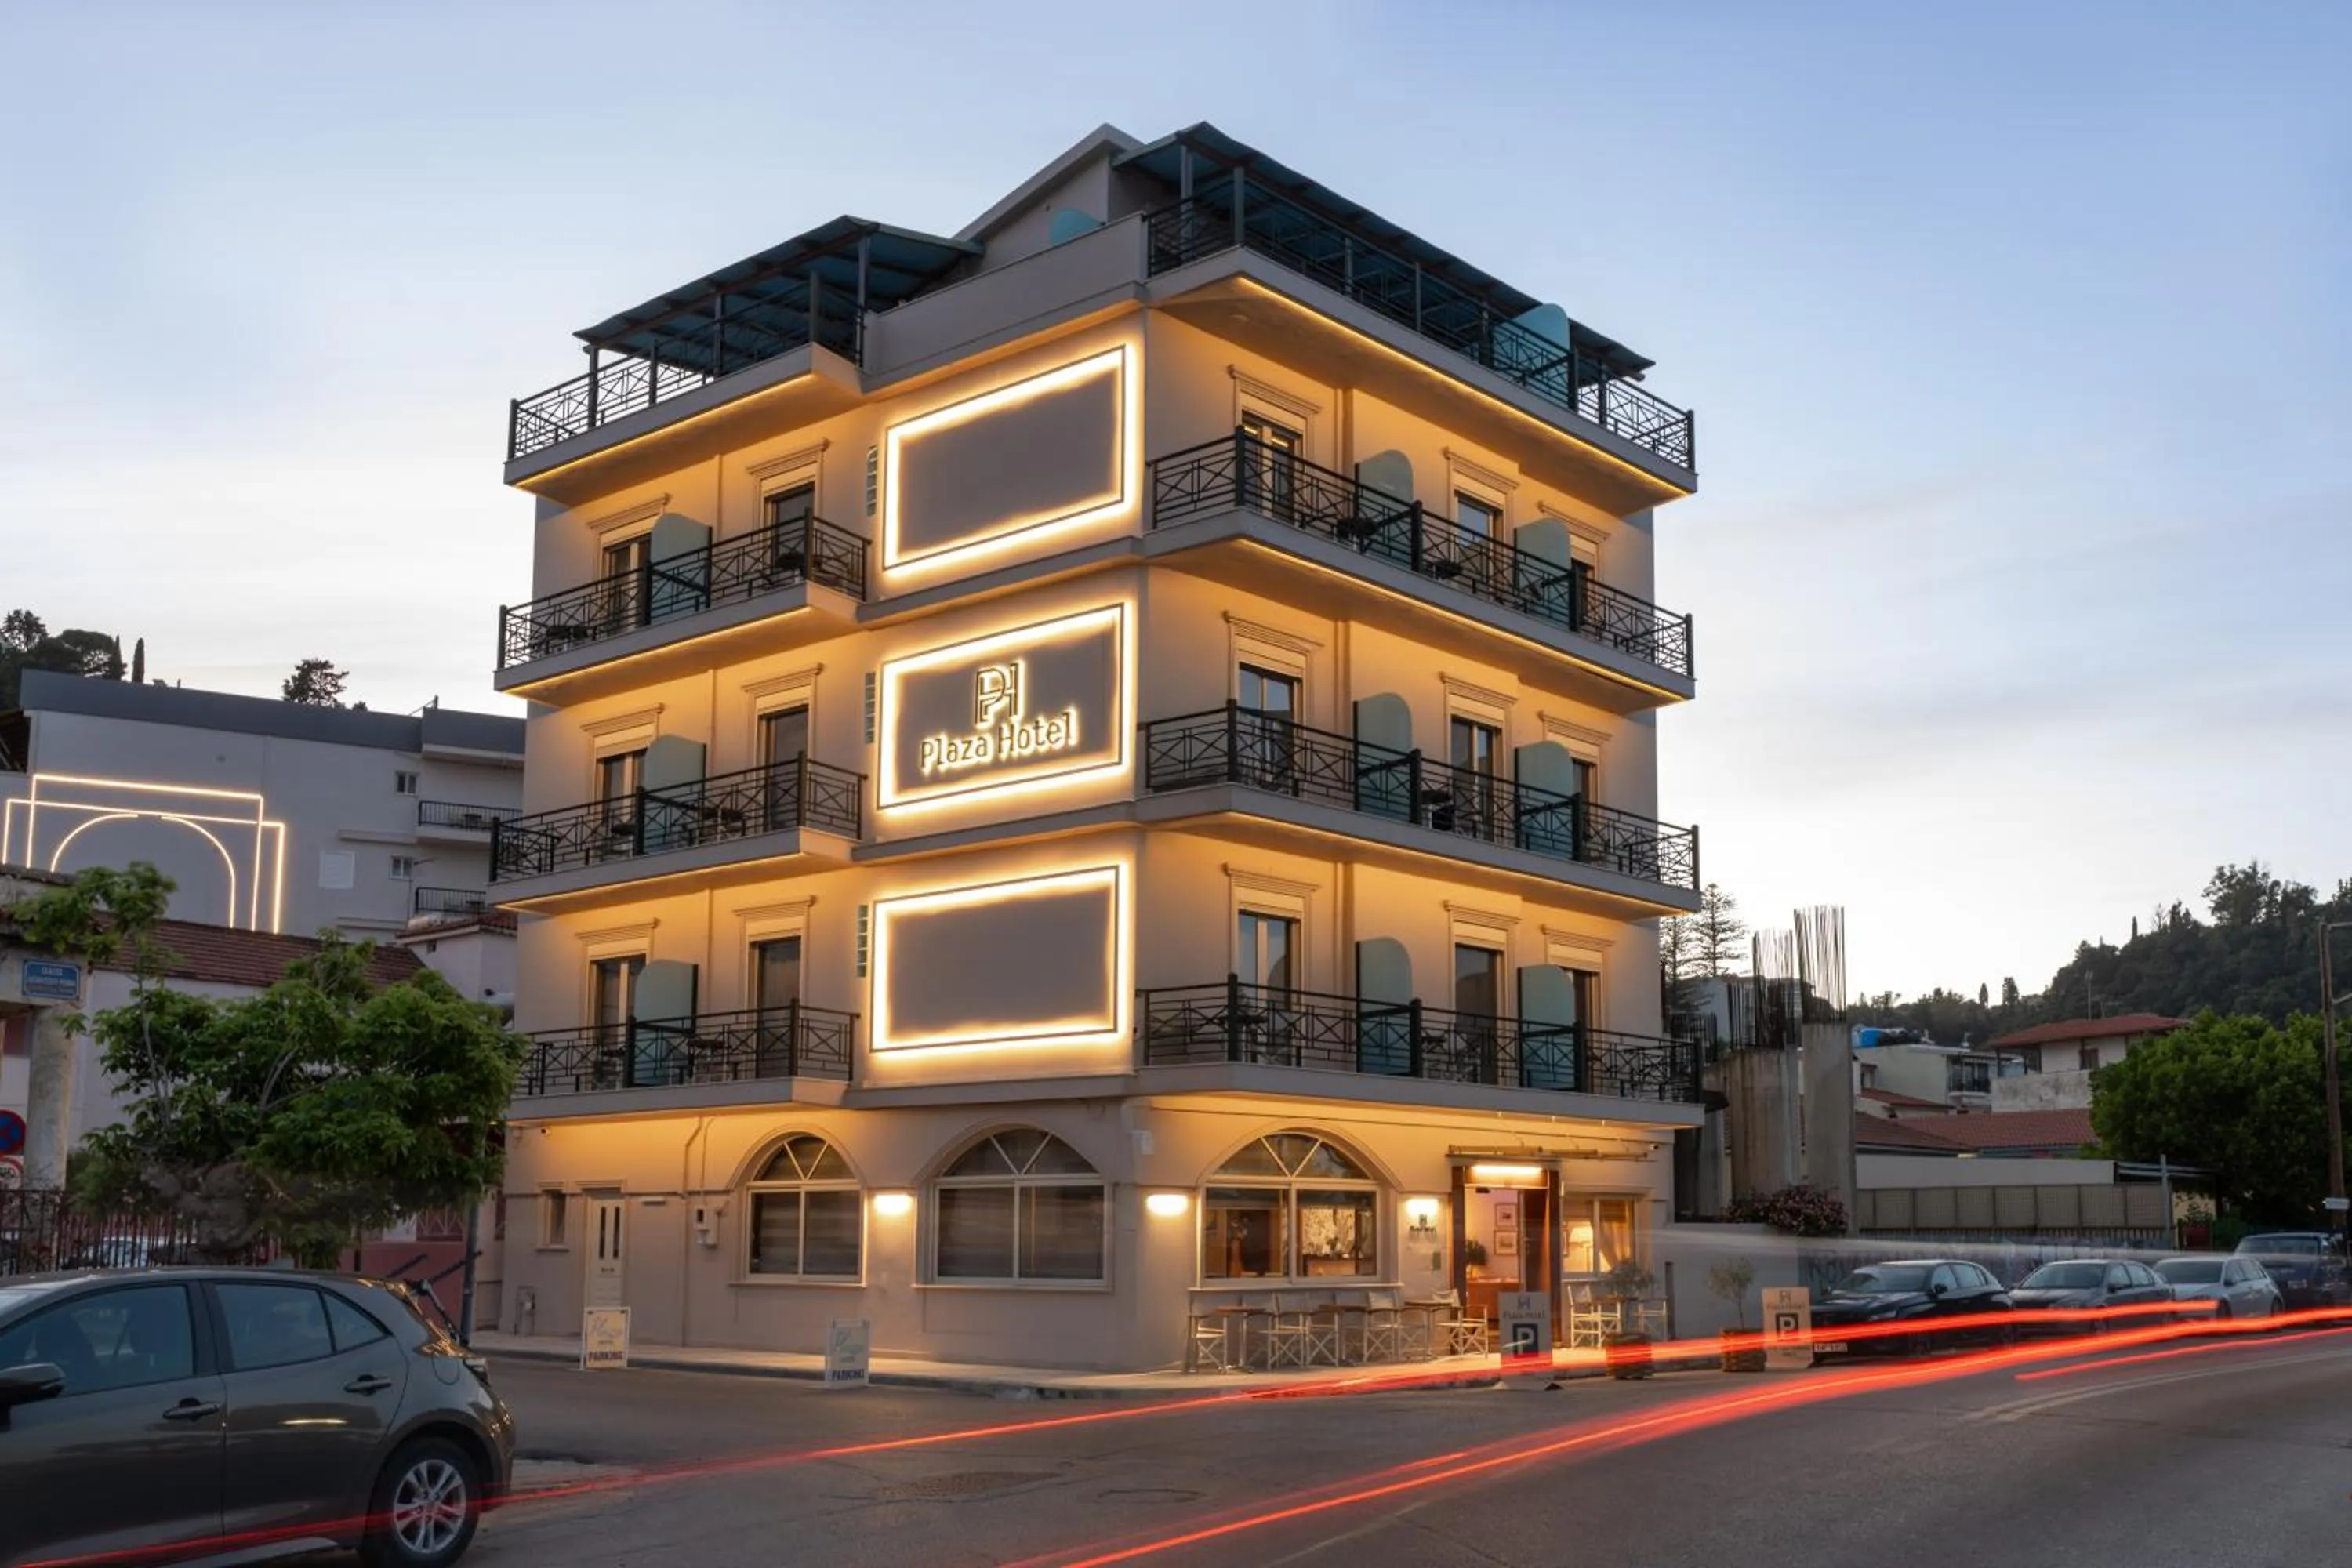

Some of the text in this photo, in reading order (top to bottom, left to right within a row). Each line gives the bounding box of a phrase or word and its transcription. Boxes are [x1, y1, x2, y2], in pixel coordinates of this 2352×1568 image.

[920, 710, 1073, 769] Plaza Hotel
[1779, 1316, 1796, 1340] P
[1517, 1327, 1534, 1356] P
[588, 1350, 623, 1363] PARKING
[831, 1368, 865, 1381] PARKING
